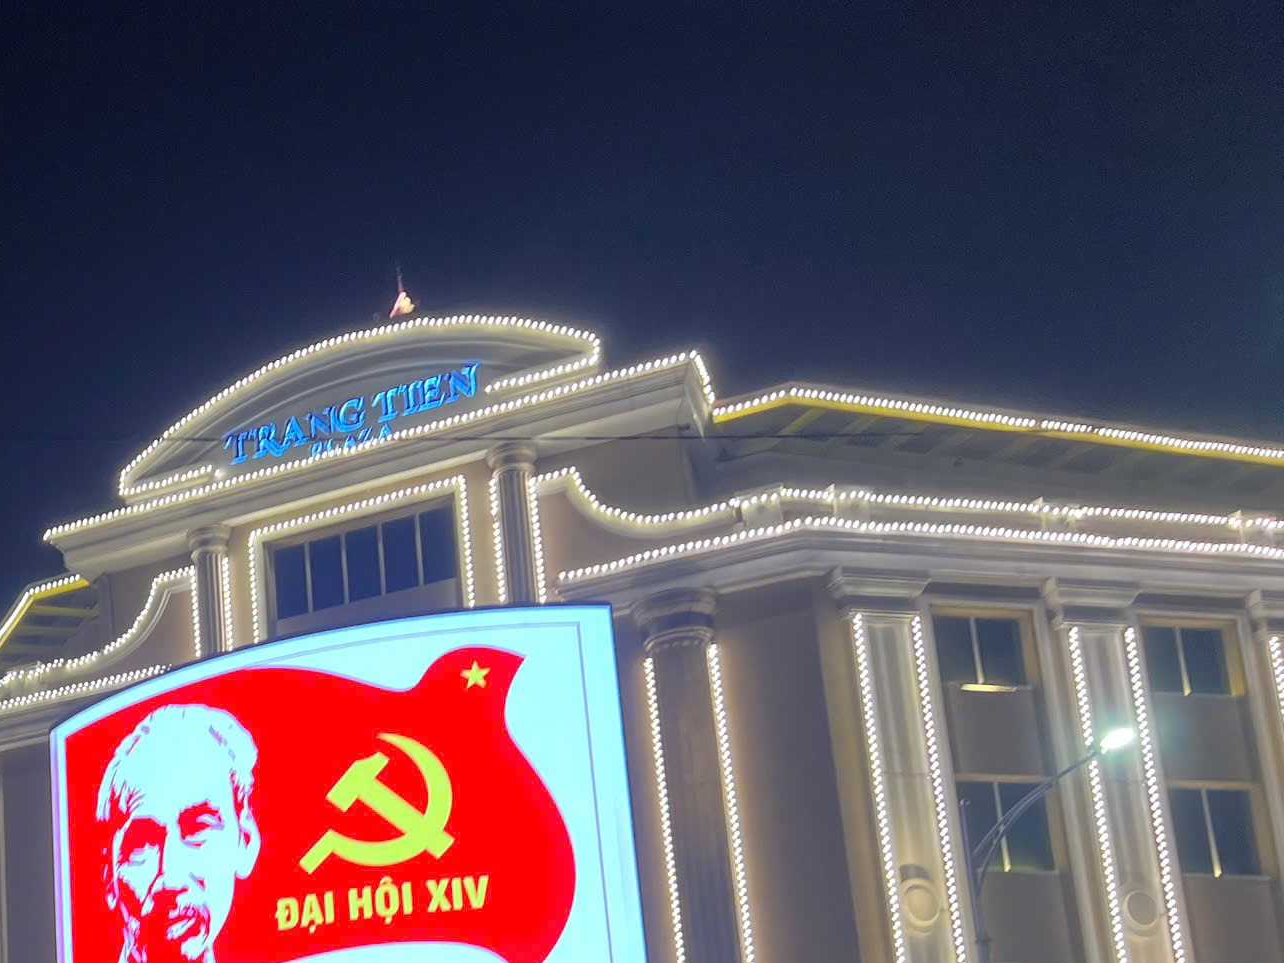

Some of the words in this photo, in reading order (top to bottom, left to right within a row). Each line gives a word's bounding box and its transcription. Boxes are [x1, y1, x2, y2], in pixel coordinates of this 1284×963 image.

[223, 397, 366, 464] TRANG
[371, 360, 481, 423] TIEN
[275, 891, 335, 934] ĐẠI
[348, 876, 414, 925] HỘI
[425, 874, 489, 913] XIV
